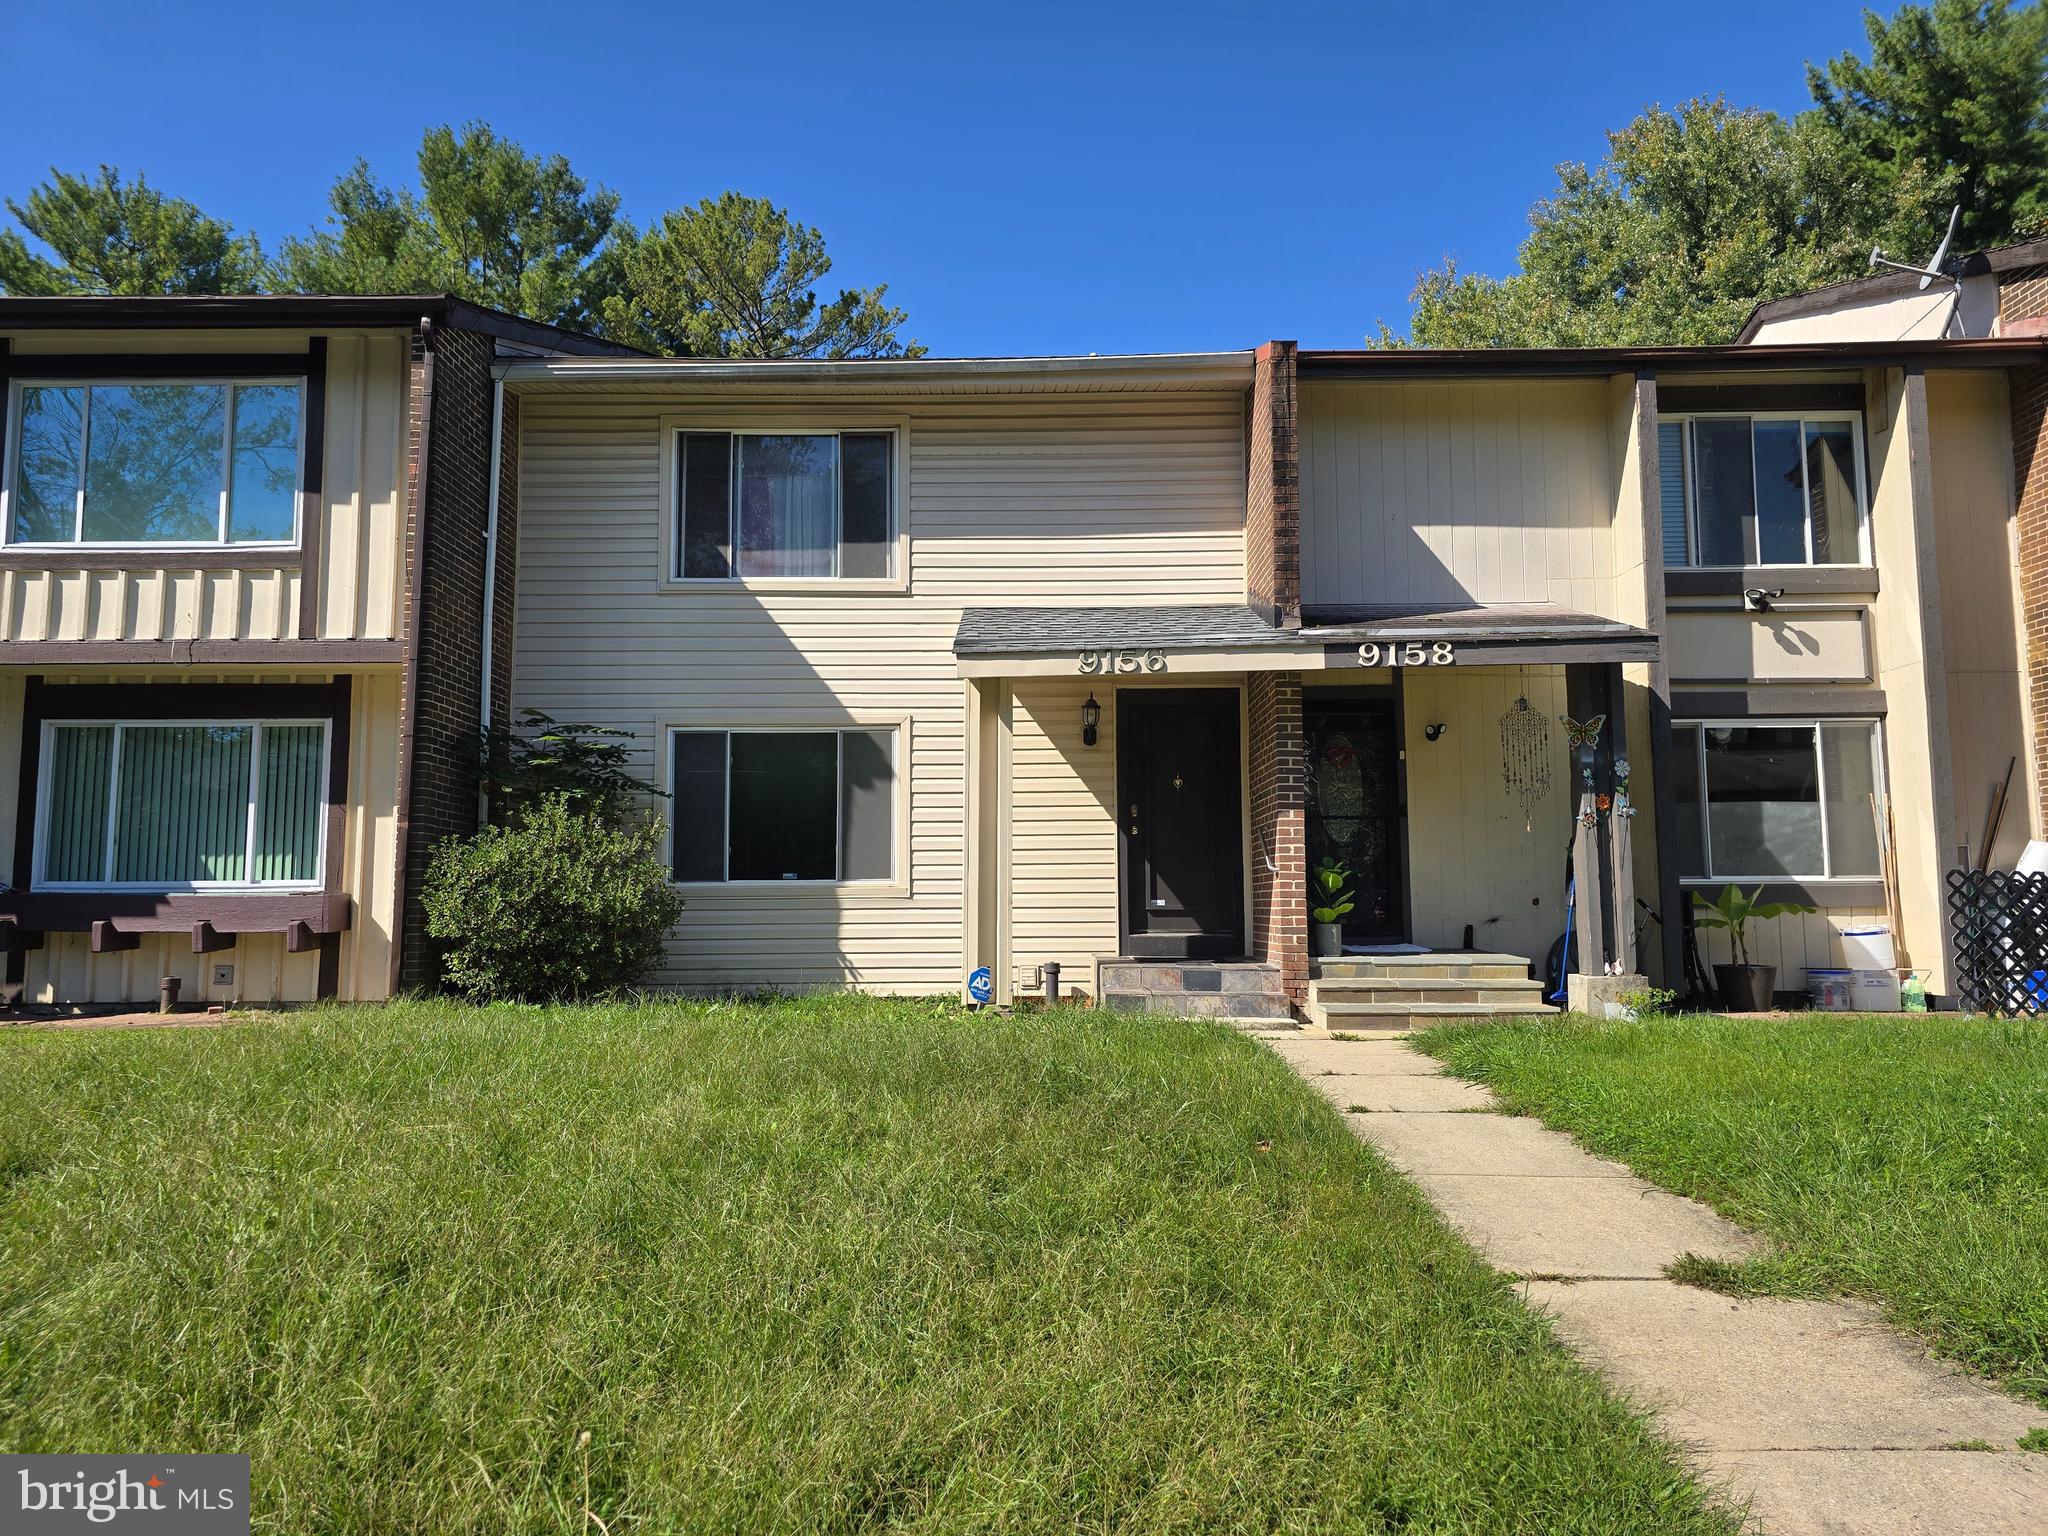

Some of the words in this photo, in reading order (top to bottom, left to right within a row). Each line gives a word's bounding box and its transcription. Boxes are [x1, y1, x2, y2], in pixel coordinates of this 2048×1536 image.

[1077, 649, 1165, 673] 9156
[1357, 641, 1454, 667] 9158
[970, 975, 991, 990] AD
